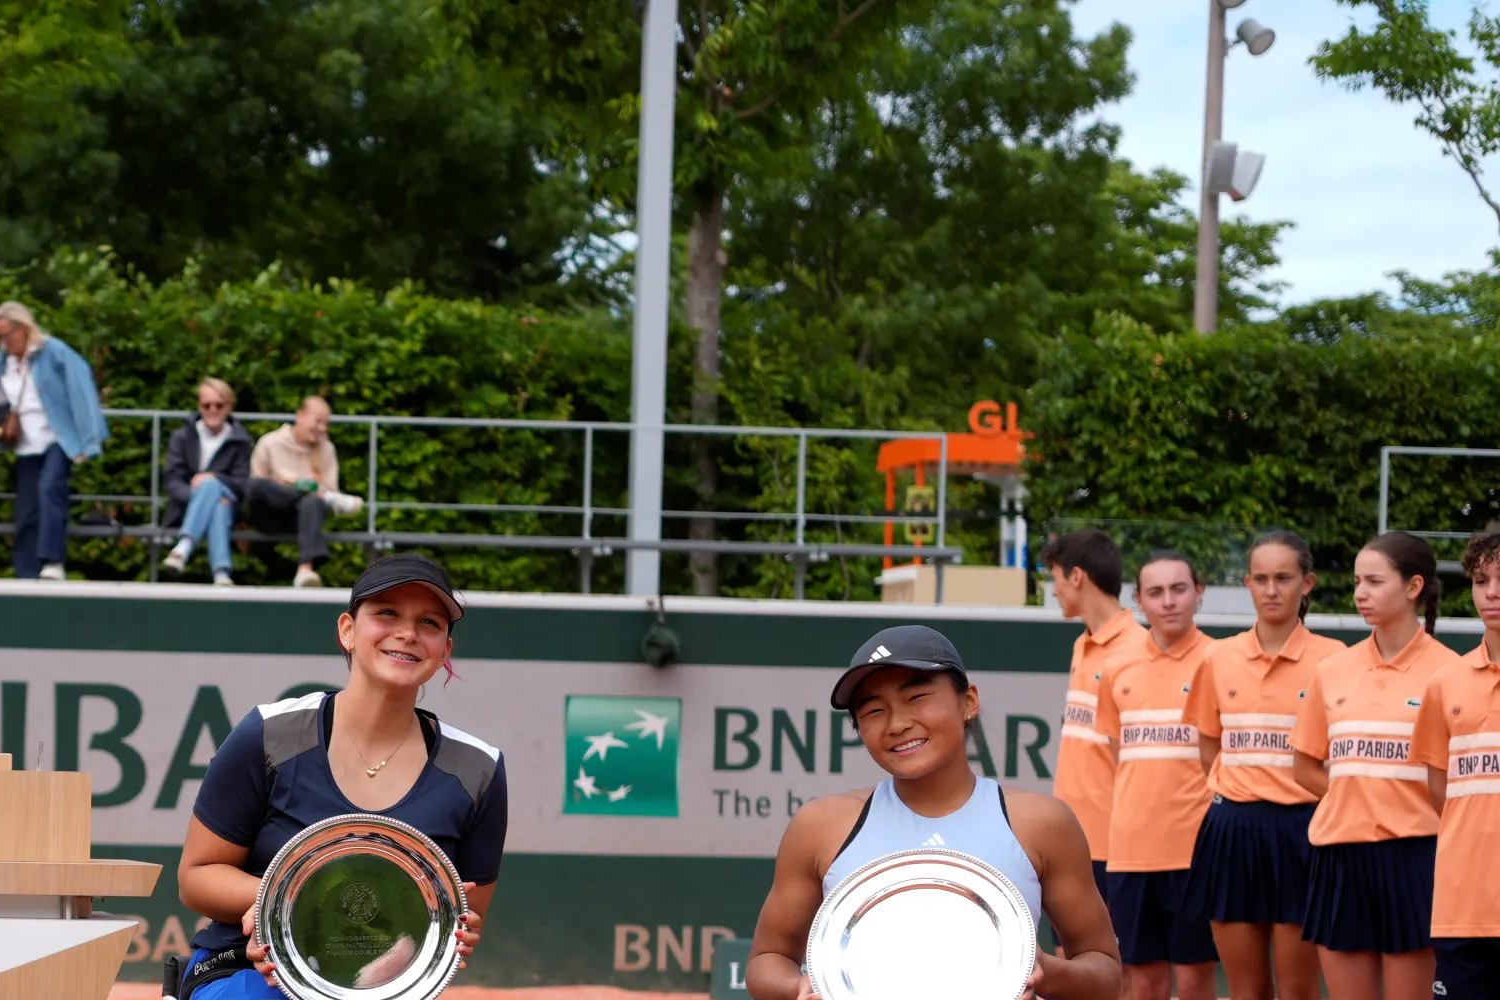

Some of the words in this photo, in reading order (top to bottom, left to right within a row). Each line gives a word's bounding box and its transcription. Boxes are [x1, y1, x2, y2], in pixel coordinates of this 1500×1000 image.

[713, 707, 866, 774] BNP
[1142, 727, 1190, 743] PARIBAS
[1230, 732, 1250, 748] BNP
[1332, 740, 1354, 758] BNP
[1458, 755, 1479, 775] BNP
[712, 789, 771, 817] The
